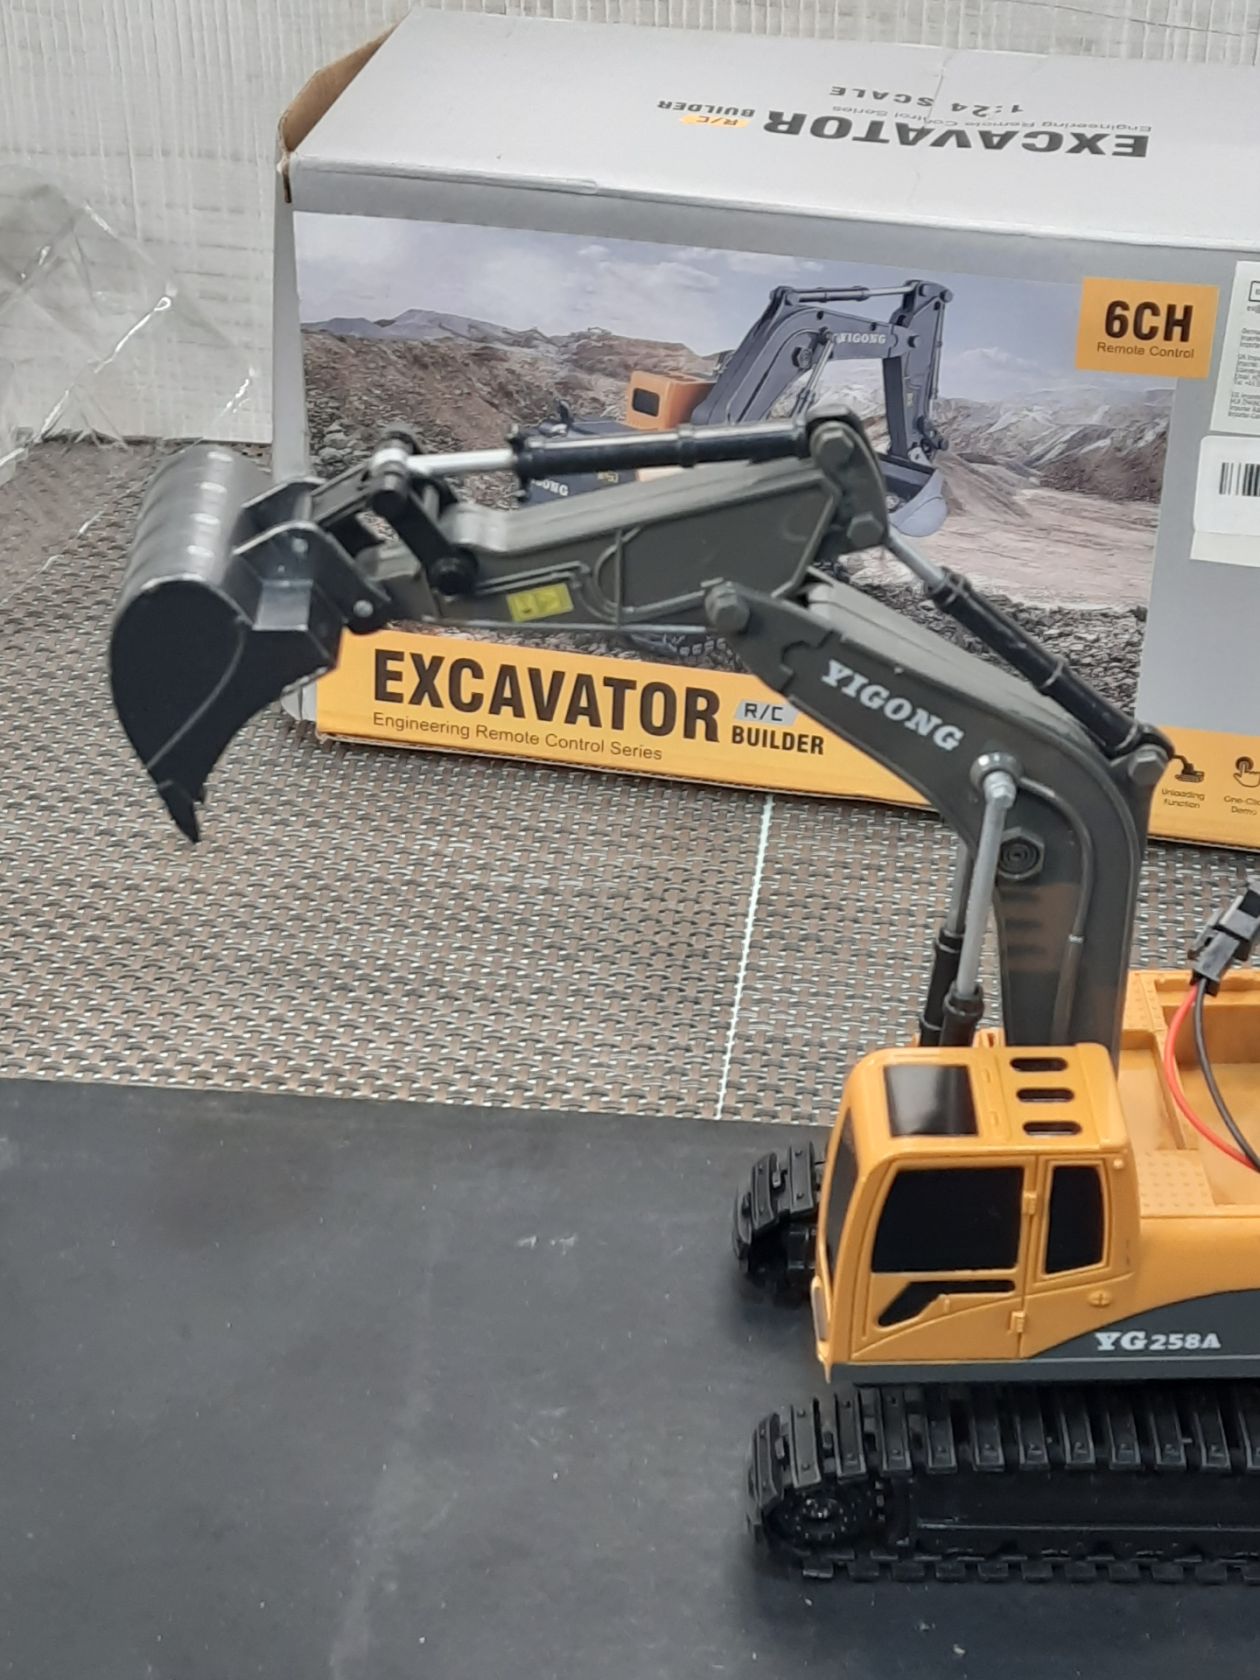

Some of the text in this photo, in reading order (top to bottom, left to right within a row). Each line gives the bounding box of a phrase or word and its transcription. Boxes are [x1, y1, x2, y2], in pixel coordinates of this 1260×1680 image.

[657, 100, 755, 117] BUILDER
[829, 86, 1023, 118] 1:24 SCALE
[832, 105, 888, 117] Series
[696, 115, 738, 126] R/C
[1042, 121, 1152, 132] Engineering
[763, 110, 1149, 158] EXCAVATOR
[1105, 300, 1193, 342] 6CH
[1097, 341, 1195, 359] Remote Control
[374, 648, 720, 743] EXCAVATOR
[821, 659, 964, 751] YIGONG
[744, 703, 784, 723] R/C
[373, 712, 663, 760] Engineering Remote Control Series
[731, 725, 825, 755] BUILDER
[1162, 788, 1205, 801] Unloading
[1164, 798, 1200, 808] Function
[1095, 1331, 1221, 1351] YG258A
